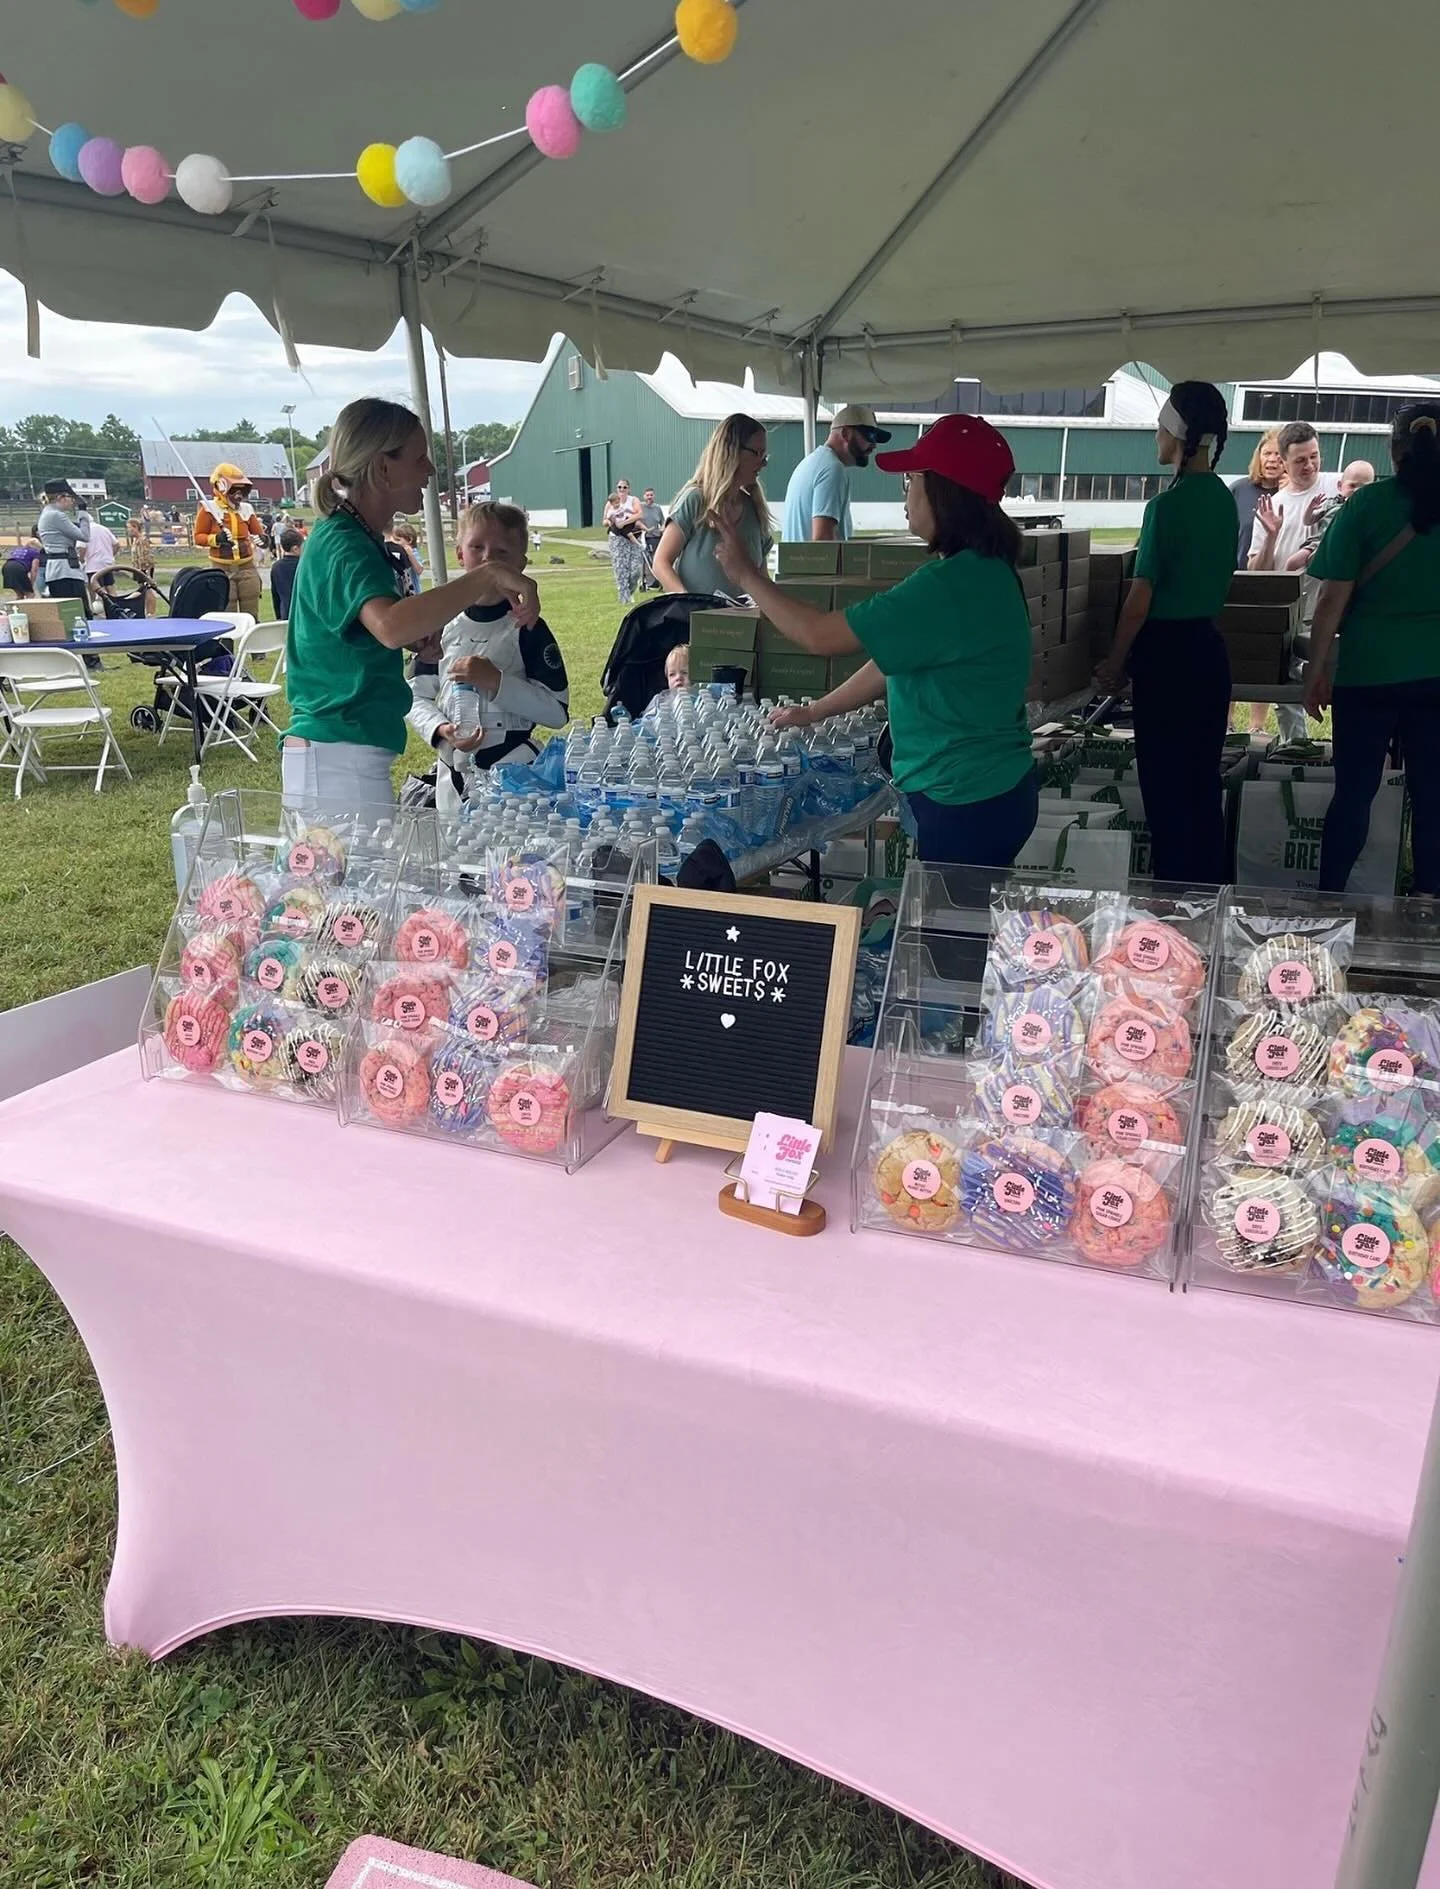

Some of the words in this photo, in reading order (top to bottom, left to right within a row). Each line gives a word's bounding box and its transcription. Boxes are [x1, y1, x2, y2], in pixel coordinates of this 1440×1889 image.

[1284, 842, 1320, 871] BRE
[685, 950, 744, 976] LITTLE
[753, 959, 790, 984] FOX
[697, 972, 766, 1001] SWEETS
[776, 1134, 812, 1153] Little
